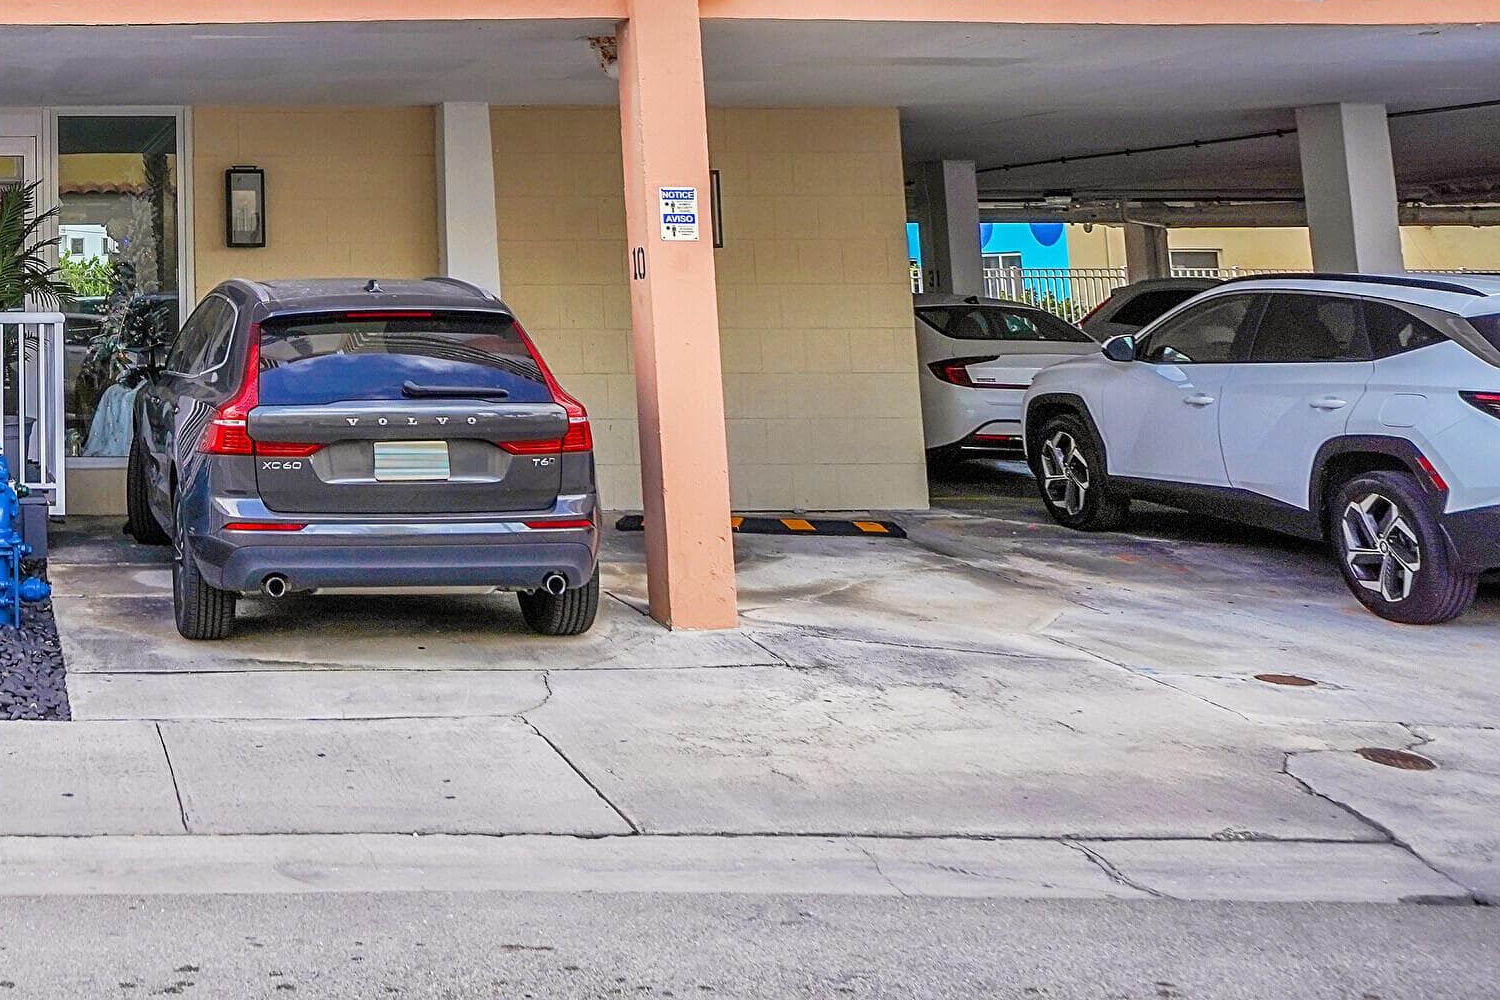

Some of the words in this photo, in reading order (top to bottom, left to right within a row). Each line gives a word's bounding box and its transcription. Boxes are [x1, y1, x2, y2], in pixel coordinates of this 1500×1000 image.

[662, 191, 694, 199] NOTICE
[665, 215, 693, 223] AVISO
[633, 247, 646, 280] 10
[346, 417, 477, 427] VOLVO
